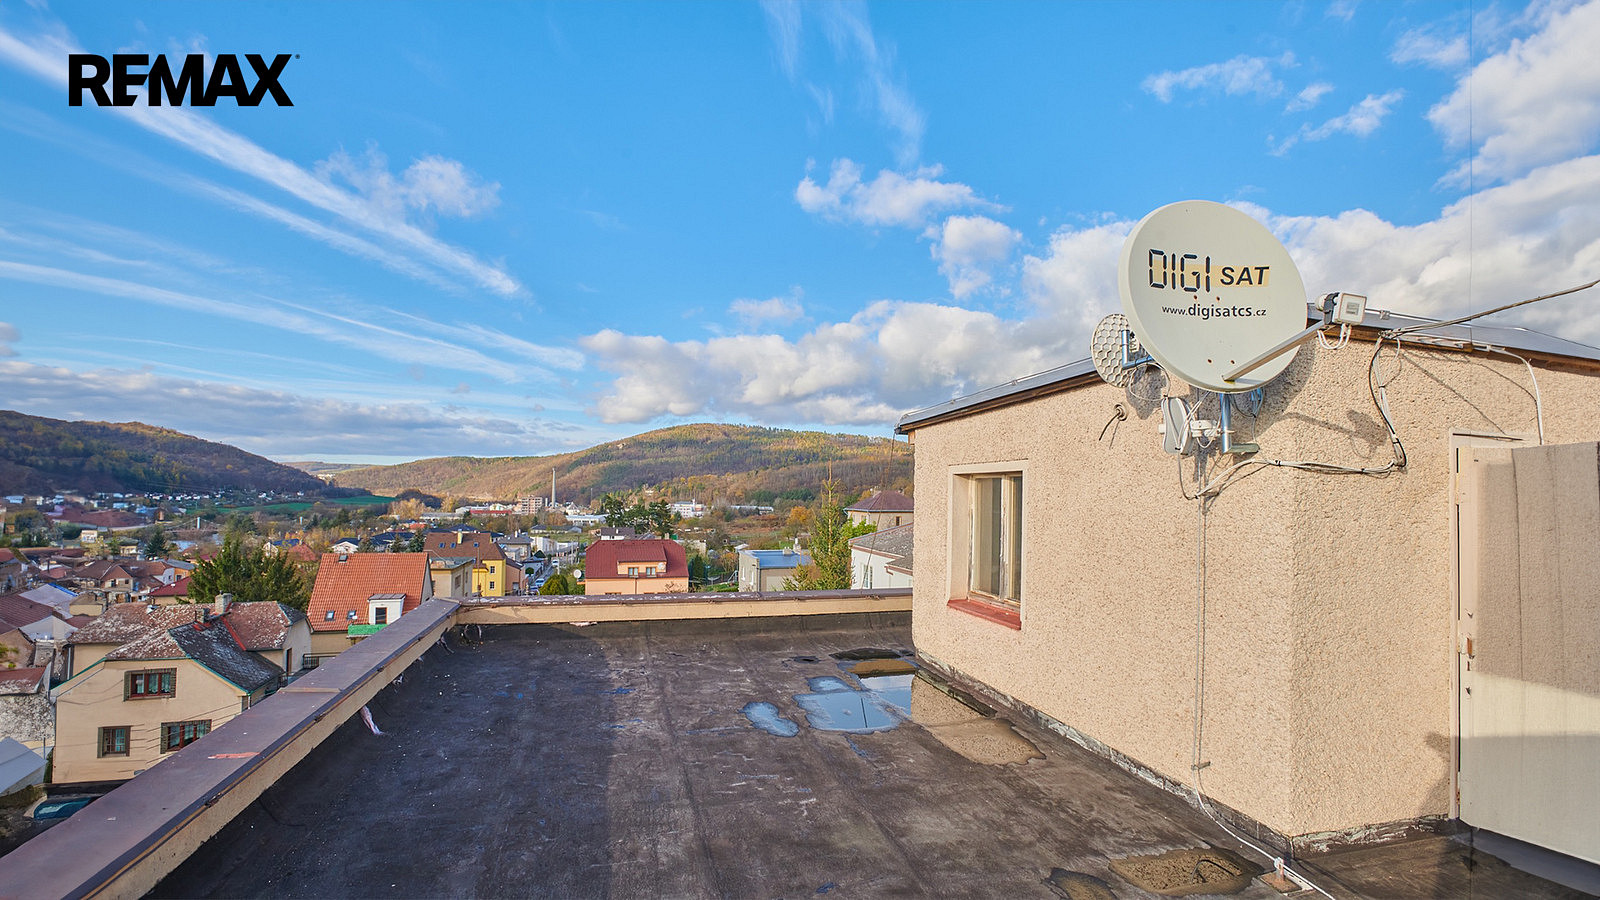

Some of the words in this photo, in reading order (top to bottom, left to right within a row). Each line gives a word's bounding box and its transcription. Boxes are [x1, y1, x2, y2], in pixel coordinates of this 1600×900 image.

[1148, 248, 1211, 293] DIGI
[1220, 266, 1270, 286] SAT
[1161, 303, 1267, 321] www.digisatcs.cz
